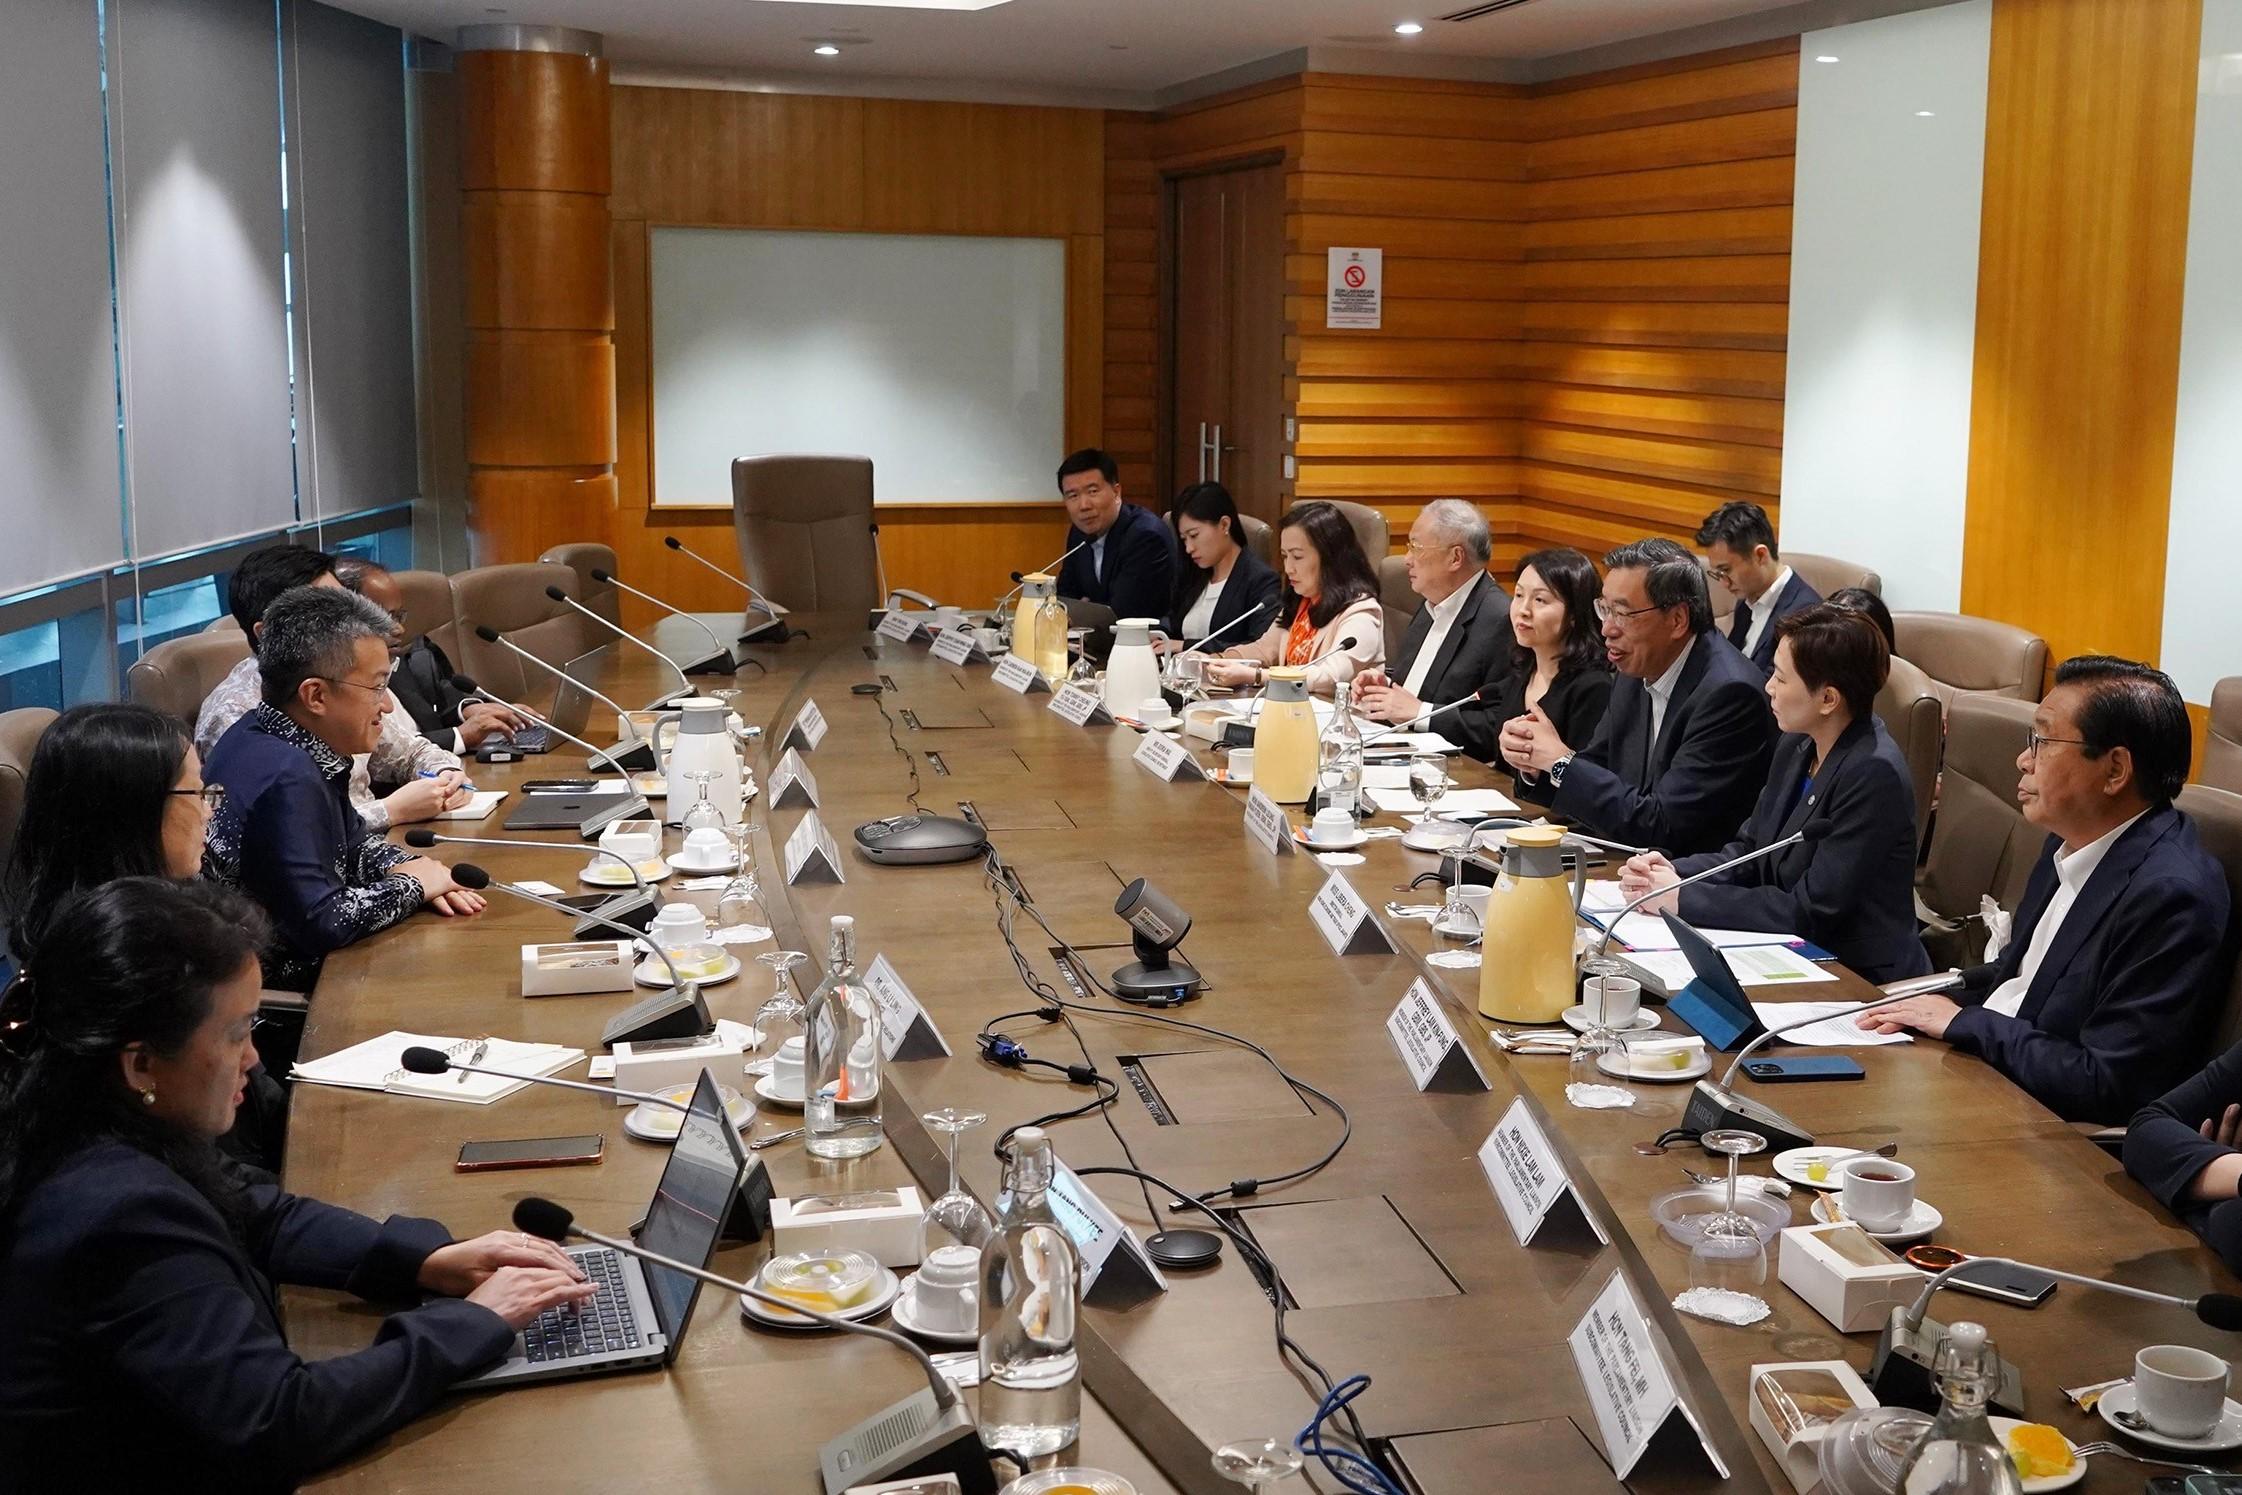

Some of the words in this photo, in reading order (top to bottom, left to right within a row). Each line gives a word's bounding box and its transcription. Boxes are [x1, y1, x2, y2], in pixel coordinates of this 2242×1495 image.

[1410, 985, 1419, 1001] HON
[1415, 994, 1431, 1020] JEFFREY
[1426, 1013, 1436, 1029] LAM
[1509, 1125, 1522, 1145] HON
[1516, 1138, 1530, 1162] NIXIE
[1525, 1154, 1537, 1175] LAM
[1532, 1167, 1545, 1189] LAM
[1591, 1308, 1605, 1337] MEMBER
[1608, 1310, 1624, 1340] HON
[1616, 1330, 1635, 1367] TANG
[1626, 1356, 1642, 1386] FEI,
[1634, 1372, 1649, 1401] MH
[1602, 1369, 1622, 1414] LEGISLATIVE
[1617, 1408, 1634, 1444] COUNCIL
